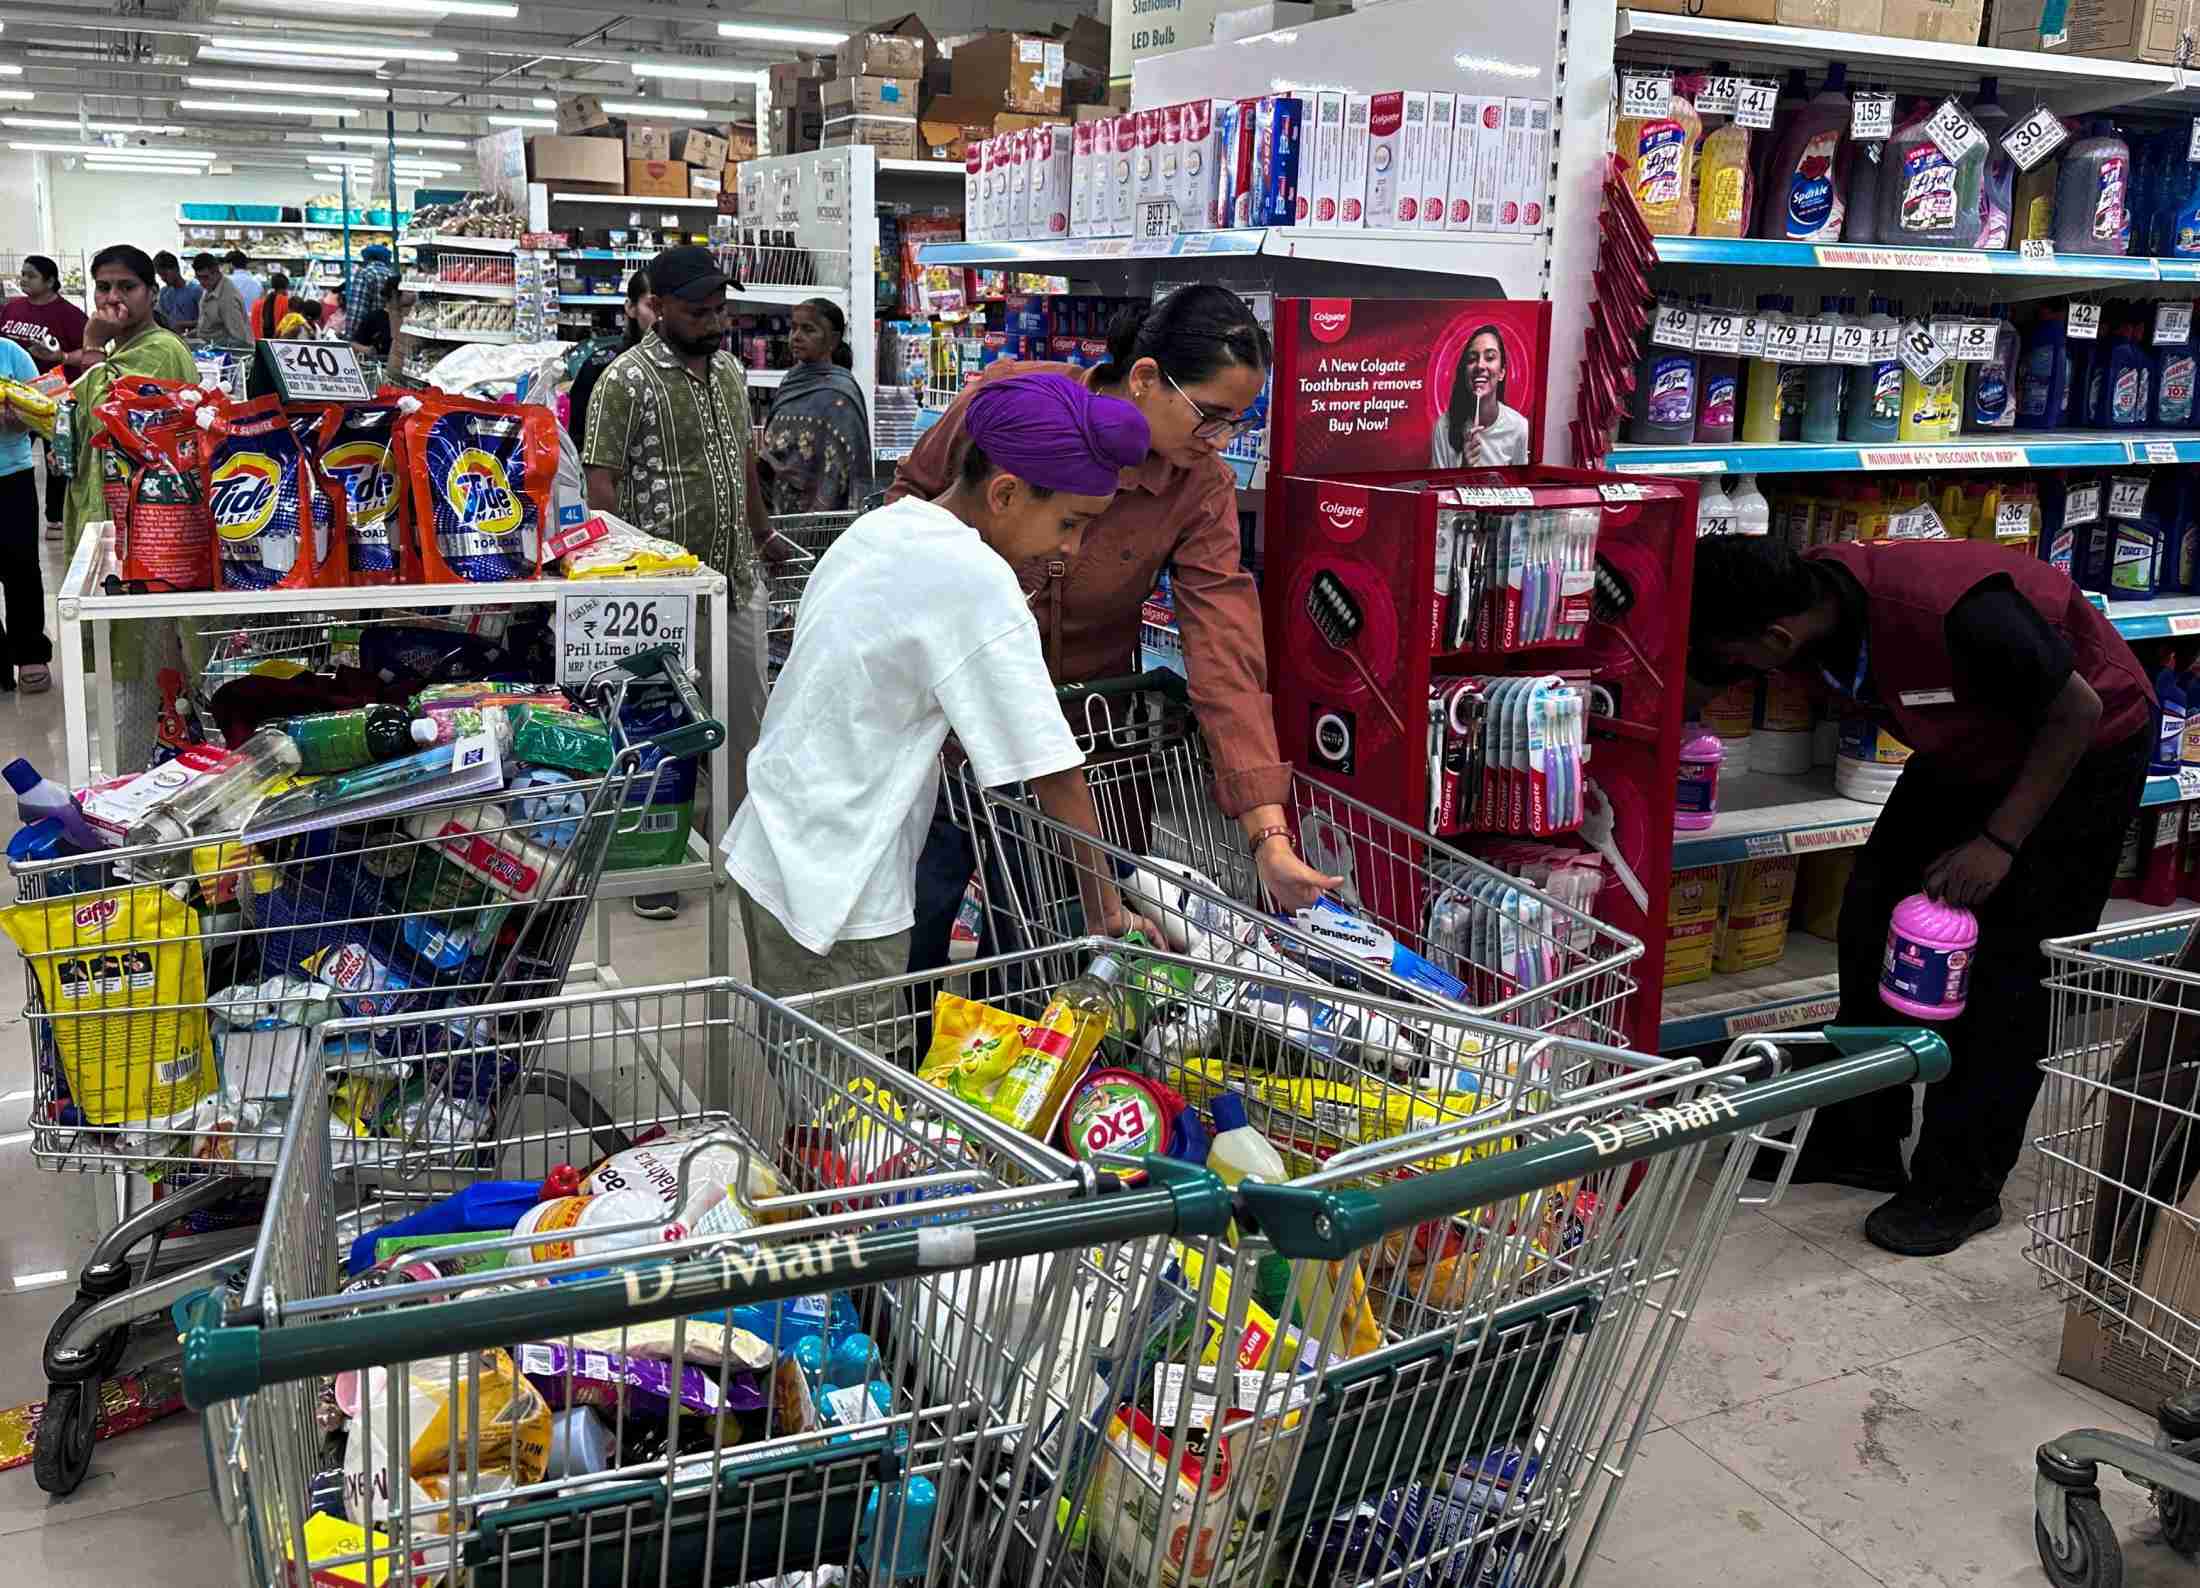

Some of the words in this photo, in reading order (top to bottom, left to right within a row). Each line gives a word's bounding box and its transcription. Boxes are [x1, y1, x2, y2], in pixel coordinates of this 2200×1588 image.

[1132, 31, 1149, 49] LED
[1152, 25, 1175, 46] Bulb
[1793, 185, 1829, 203] Sparkle
[1147, 204, 1164, 220] BUY
[1167, 203, 1172, 219] 1
[1146, 221, 1163, 236] GET
[1164, 221, 1169, 235] 1
[1823, 249, 1872, 264] MINIMUM
[1895, 254, 1938, 268] DISCOUNT
[1313, 311, 1346, 323] Colgate
[1, 320, 49, 338] FLORIDA
[1318, 360, 1329, 373] A
[1331, 359, 1359, 373] New
[1360, 358, 1407, 376] Colgate
[1299, 378, 1369, 393] Toothbrush
[1372, 378, 1423, 391] removes
[1659, 374, 1688, 390] Lizol
[1311, 399, 1326, 412] 5x
[1328, 401, 1361, 412] more
[1363, 398, 1409, 418] plaque.
[1328, 419, 1353, 436] Buy
[1355, 418, 1389, 433] Now!
[1868, 451, 1912, 466] MINIMUM
[1936, 450, 1979, 465] DISCOUNT
[1981, 451, 1994, 464] ON
[211, 475, 274, 515] Tide
[456, 473, 512, 522] Tide
[215, 511, 262, 525] MATIC
[475, 507, 513, 521] MATIC
[564, 508, 580, 522] 4L
[1319, 500, 1364, 518] Colgate
[473, 538, 497, 549] TOP
[1503, 600, 1516, 648] Colgate
[659, 627, 686, 640] Off
[566, 643, 591, 657] Pril
[595, 642, 631, 657] Lime
[567, 660, 585, 673] MRP
[1341, 760, 1351, 774] 2
[1440, 781, 1453, 828] Colgate
[1511, 783, 1521, 831] Colgate
[1533, 782, 1542, 832] Colgate
[1793, 830, 1839, 849] MINIMUM
[1311, 923, 1376, 948] Panasonic
[1731, 1011, 1778, 1032] MINIMUM
[1088, 1102, 1146, 1151] EXO
[1244, 1331, 1261, 1357] BUY
